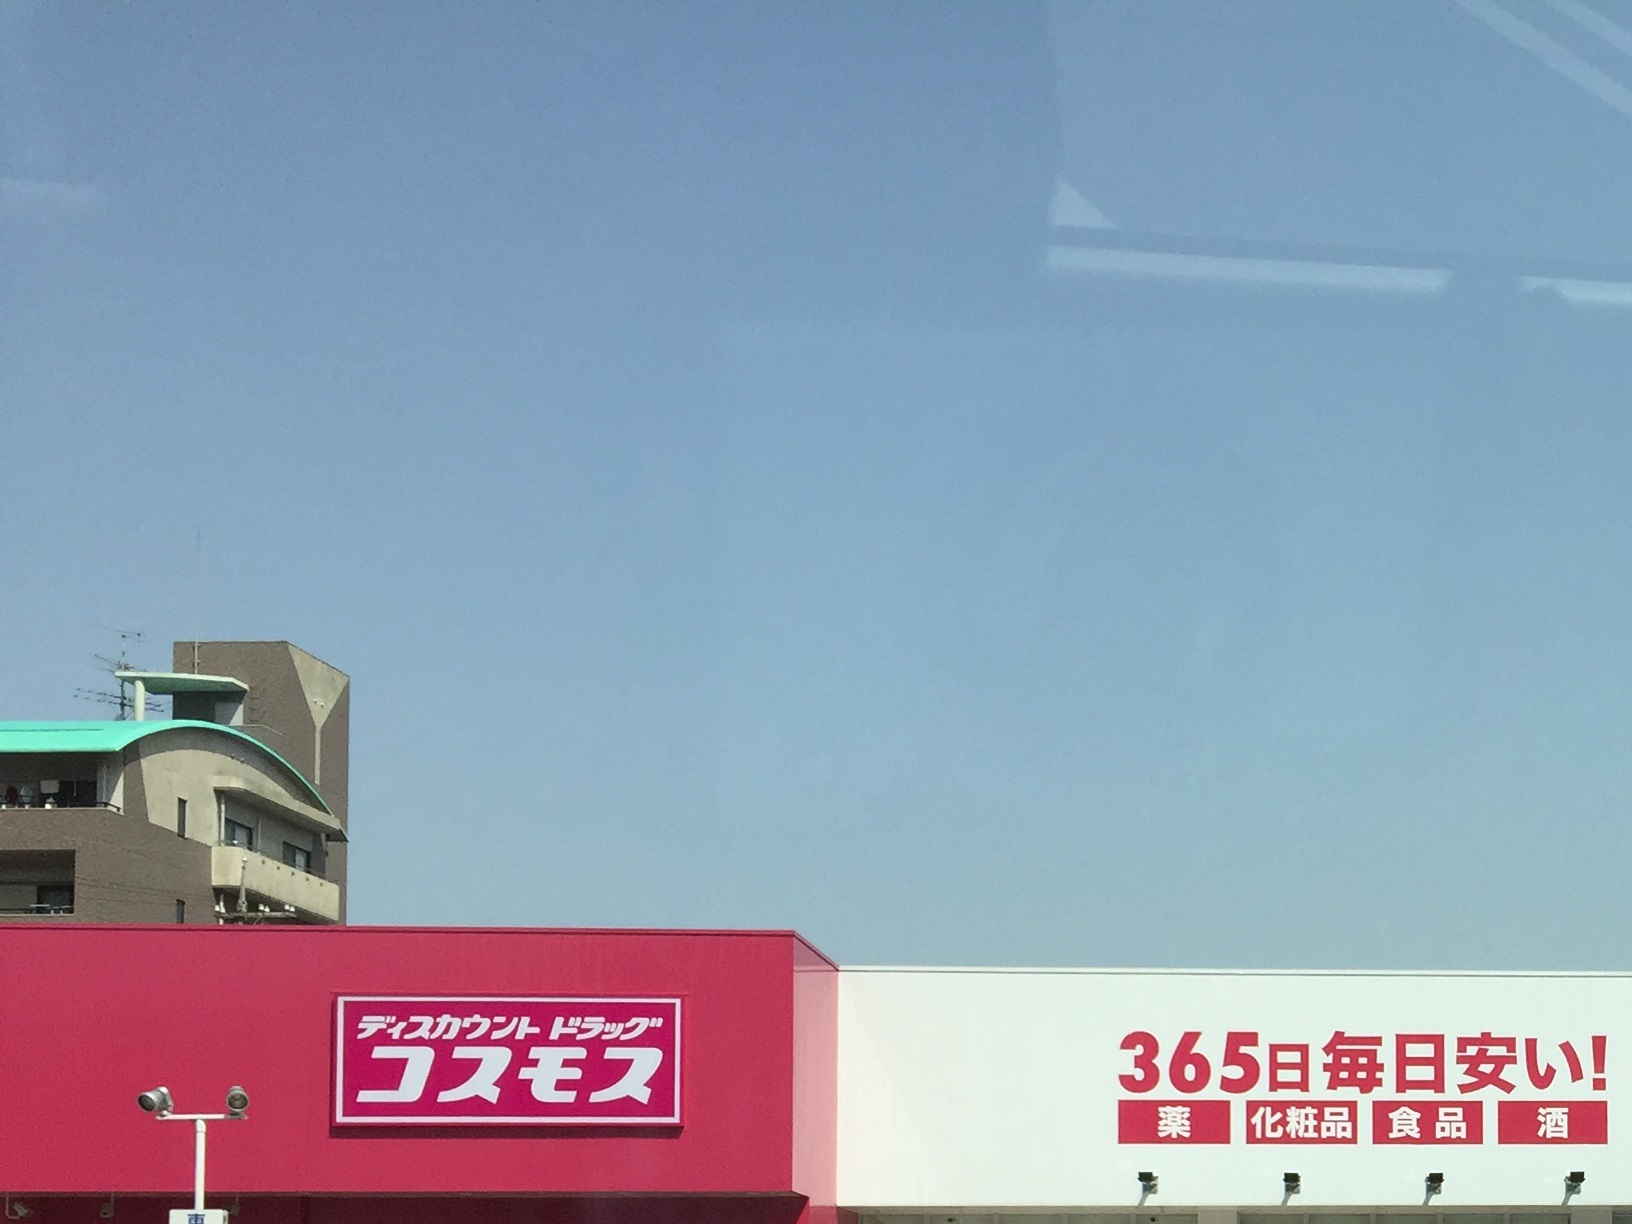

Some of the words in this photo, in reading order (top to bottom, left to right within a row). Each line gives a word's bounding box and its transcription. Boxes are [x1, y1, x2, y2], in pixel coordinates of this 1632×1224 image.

[357, 1014, 540, 1040] ディスカウント
[549, 1016, 664, 1041] ドラッグ
[356, 1046, 664, 1105] コスモス
[1157, 1106, 1192, 1139] 薬
[1250, 1106, 1354, 1140] 化粧品
[1536, 1107, 1570, 1139] 酒
